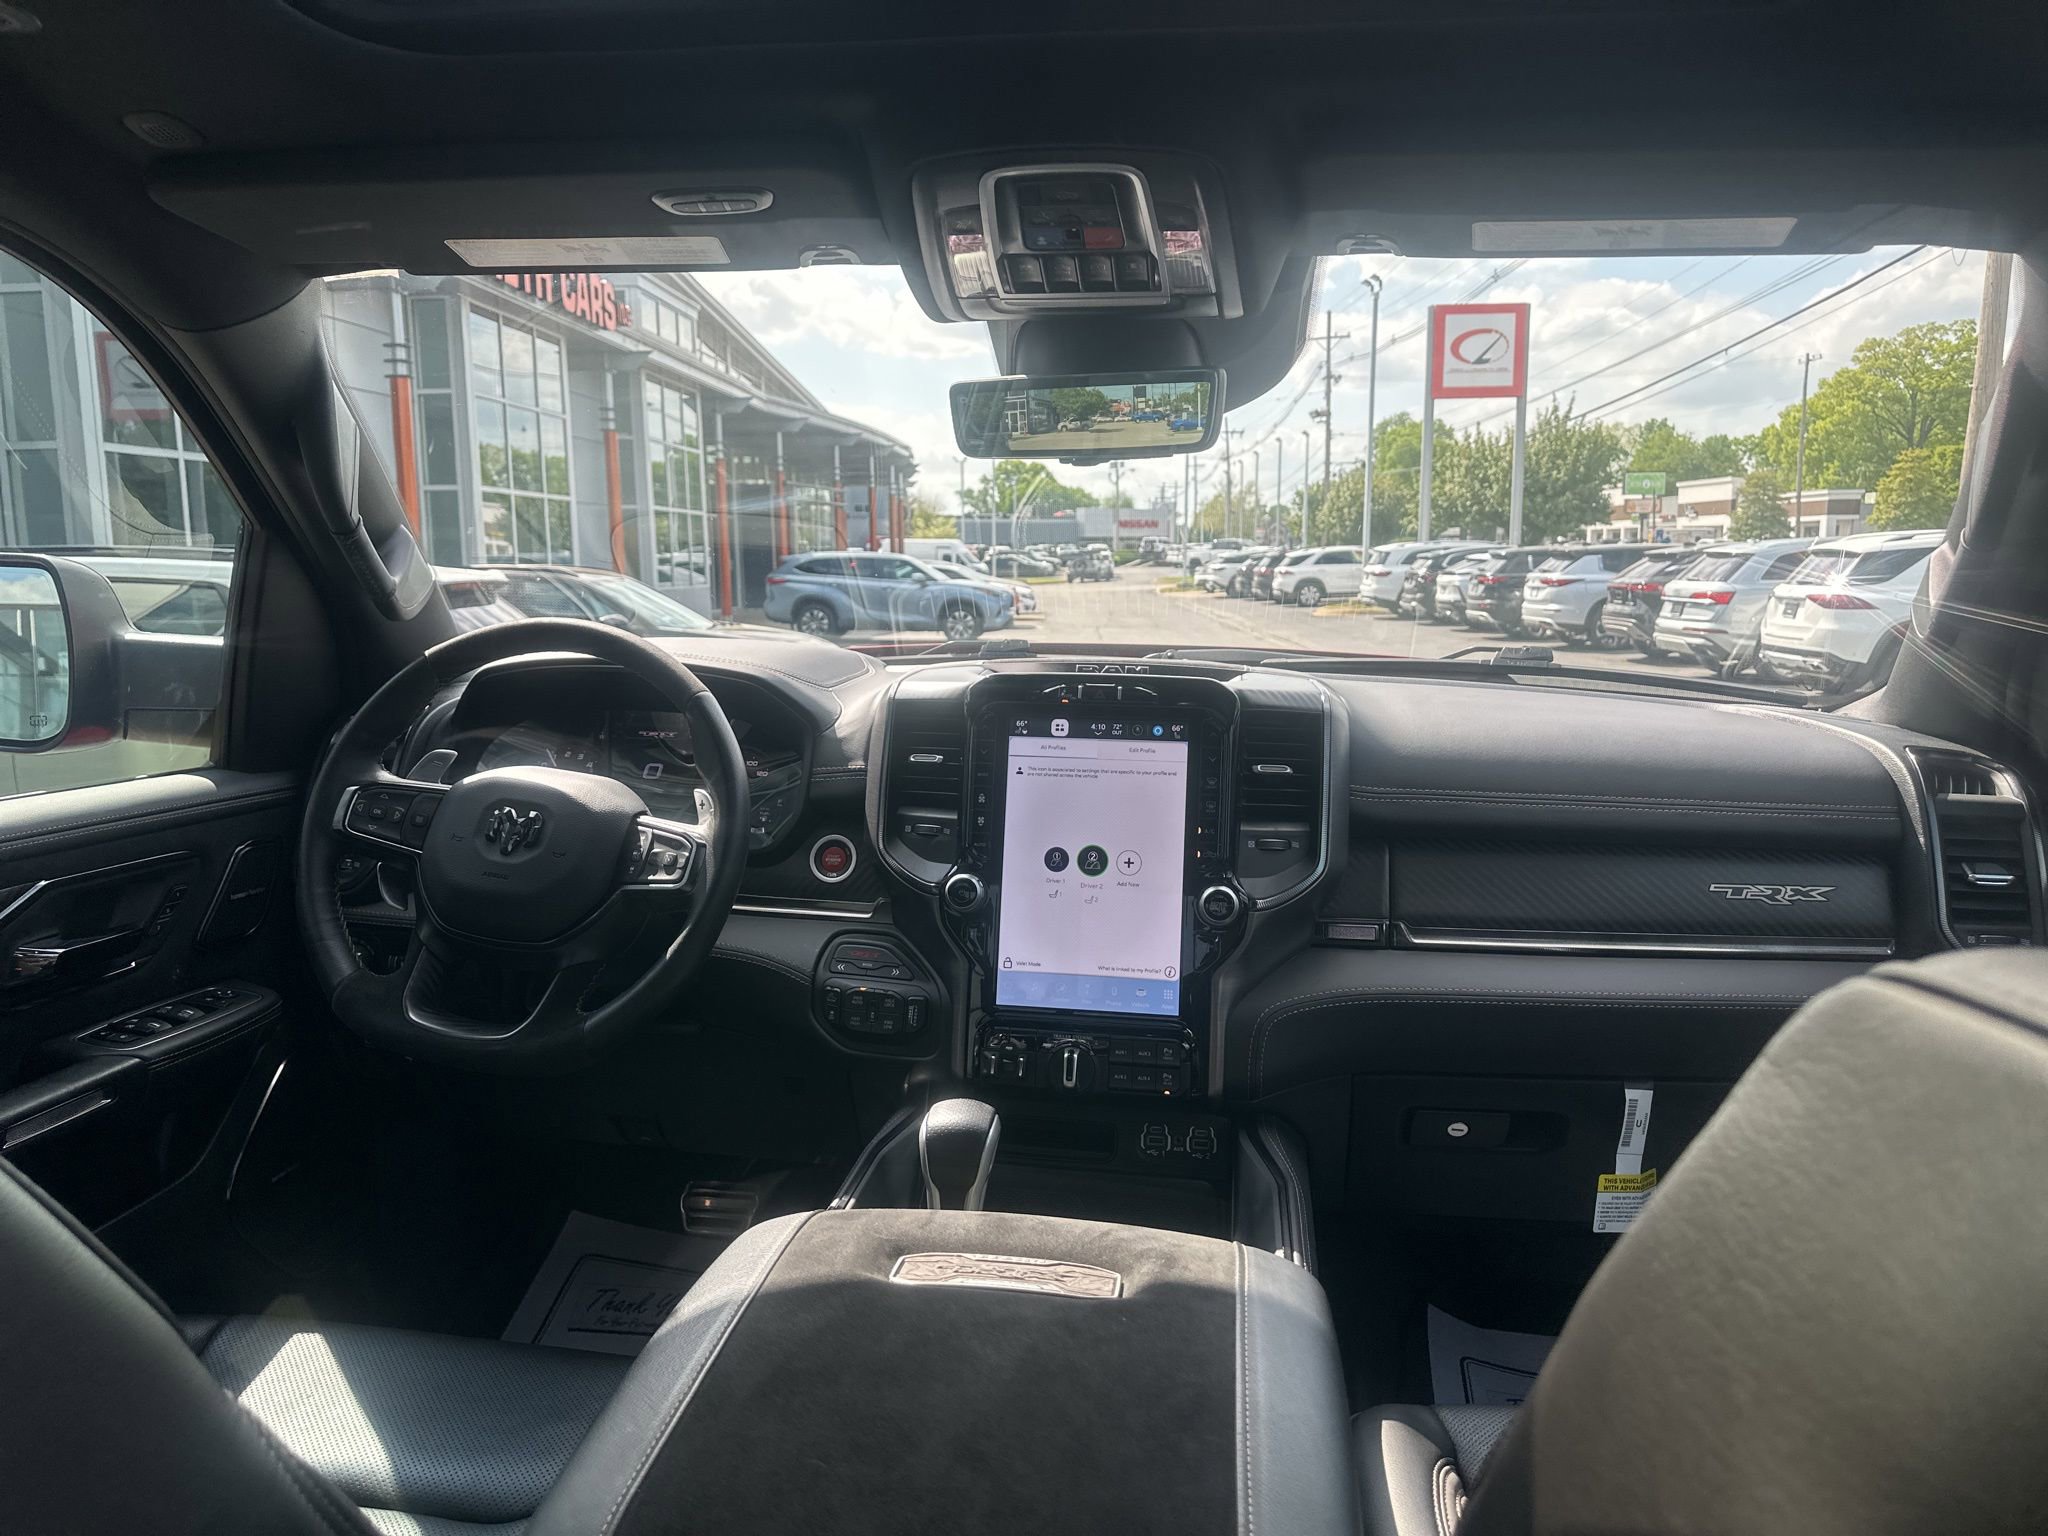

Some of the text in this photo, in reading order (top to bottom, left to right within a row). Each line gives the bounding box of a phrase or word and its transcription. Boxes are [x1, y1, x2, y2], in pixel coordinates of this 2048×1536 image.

[560, 274, 616, 332] CARS
[1119, 519, 1159, 529] NISSAN
[1091, 723, 1106, 731] 4:10
[1709, 883, 1837, 905] TRX
[586, 1288, 656, 1315] Thank
